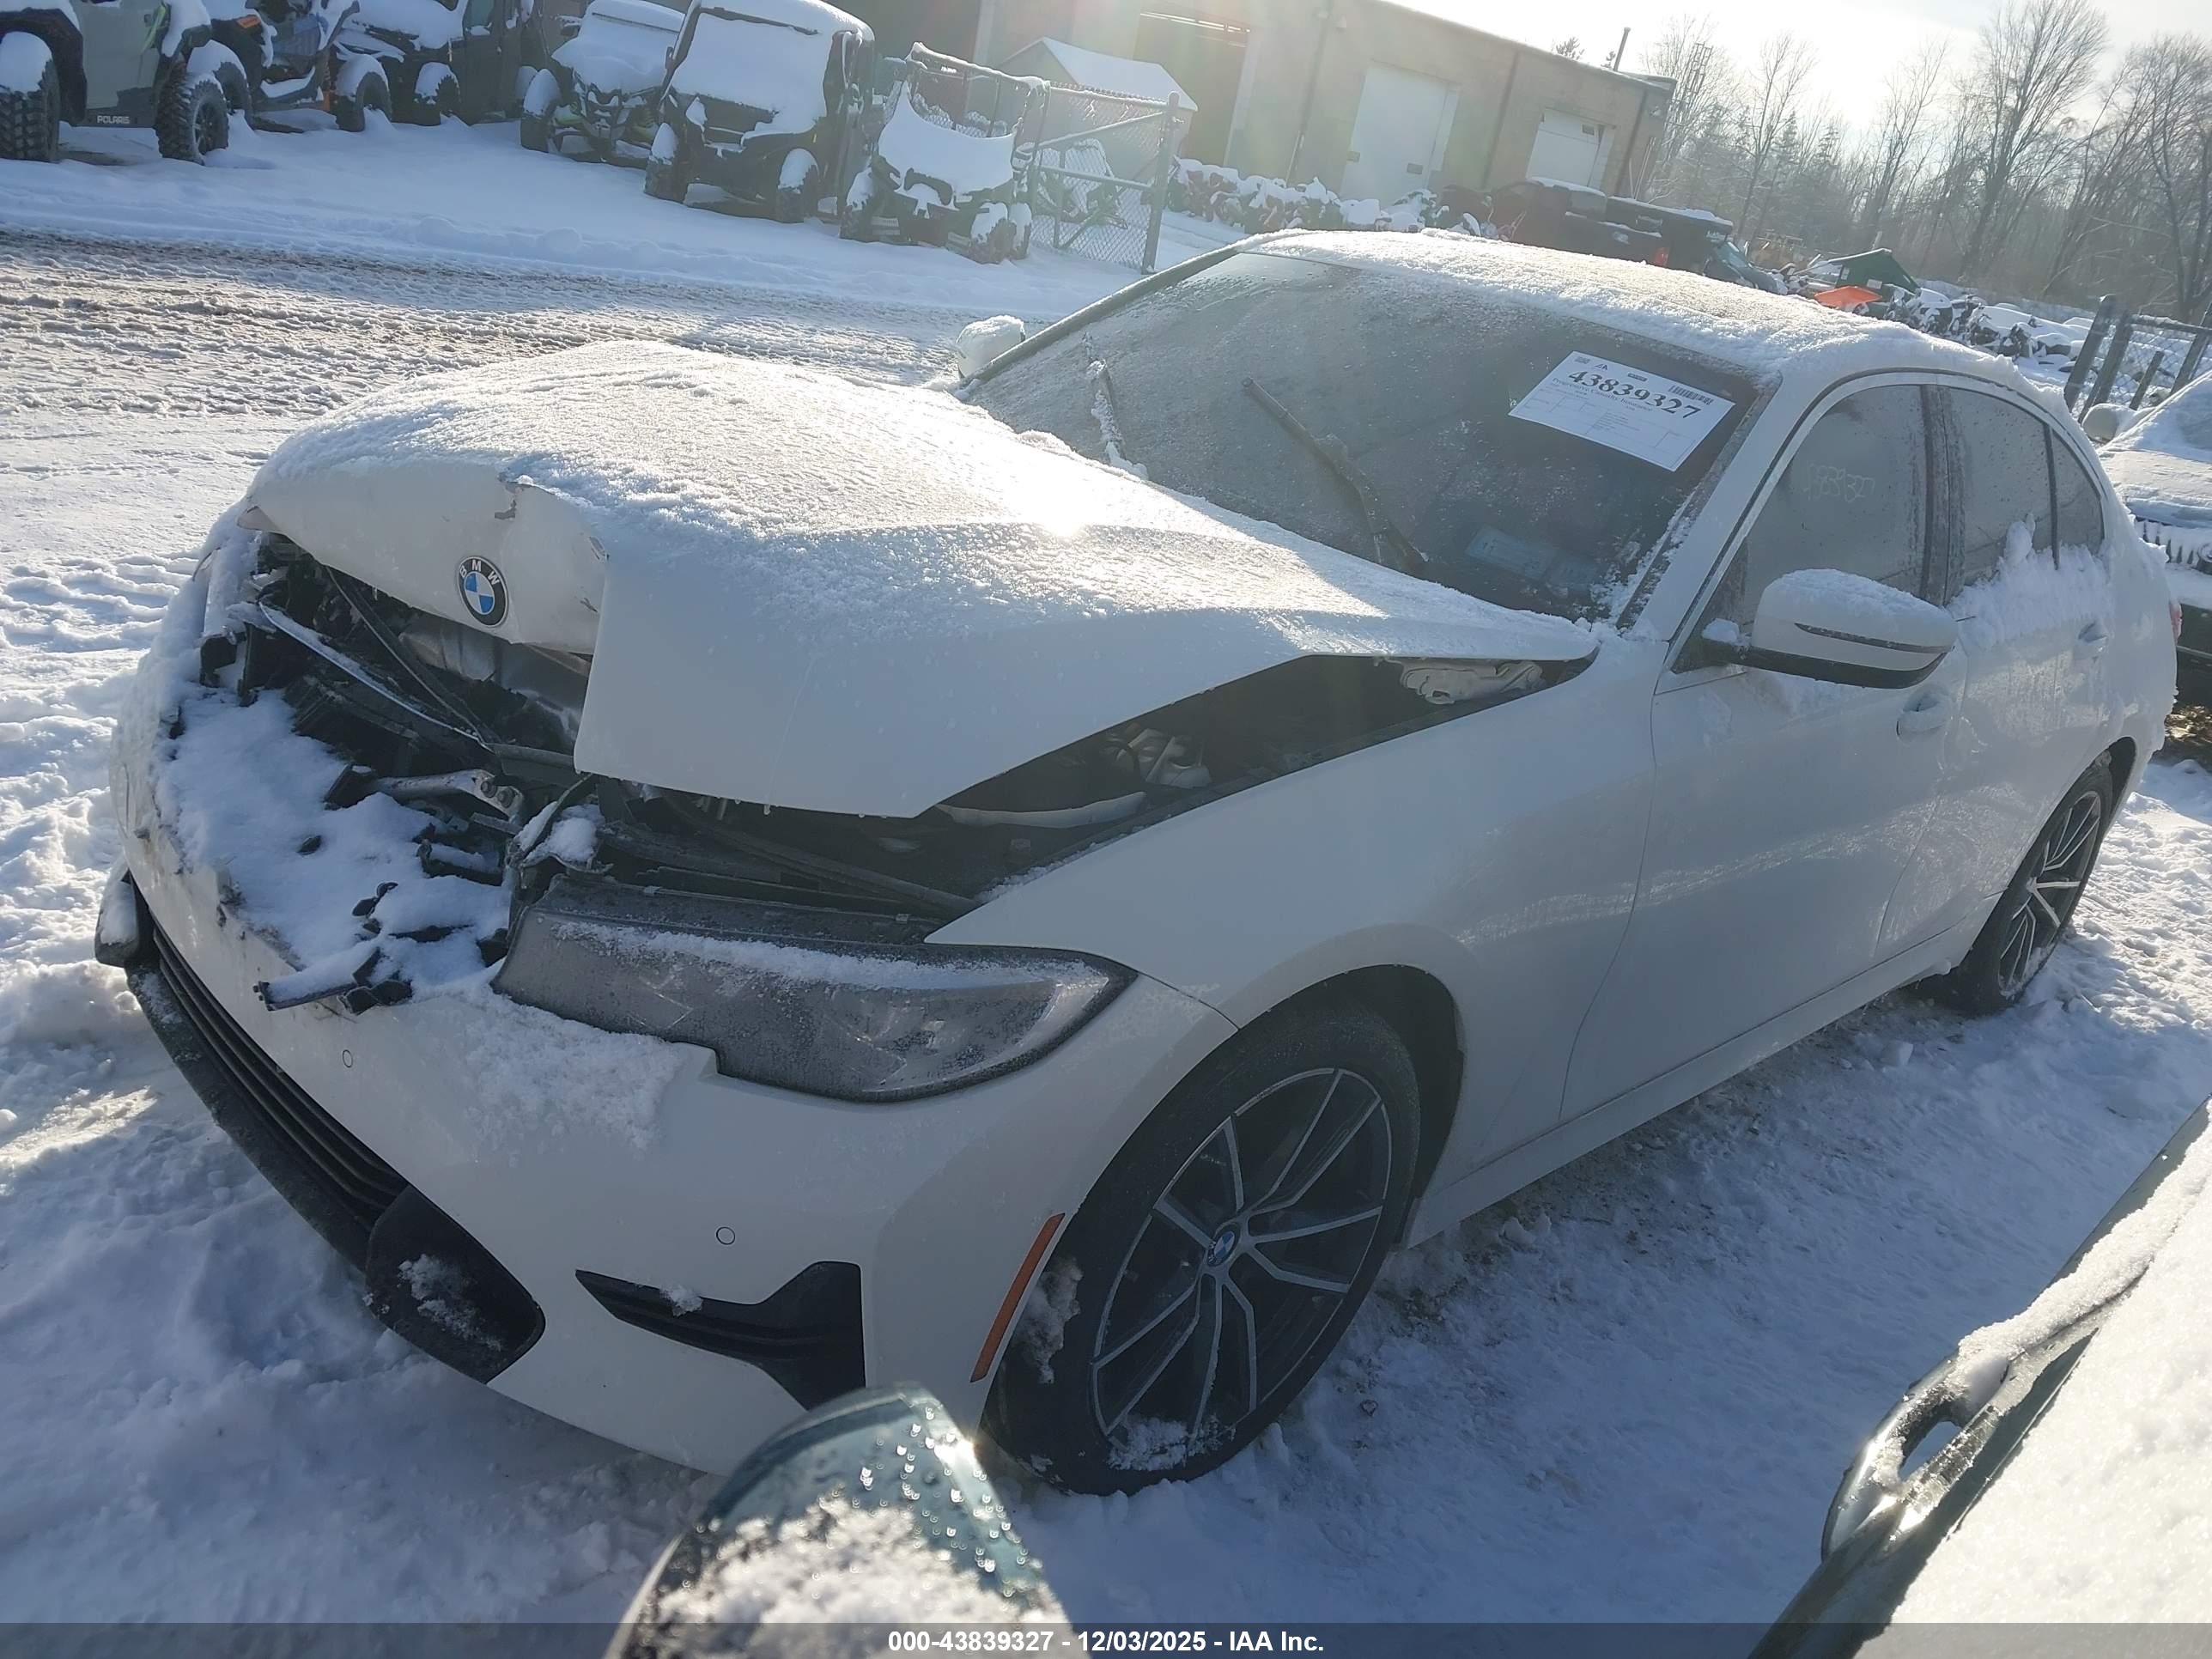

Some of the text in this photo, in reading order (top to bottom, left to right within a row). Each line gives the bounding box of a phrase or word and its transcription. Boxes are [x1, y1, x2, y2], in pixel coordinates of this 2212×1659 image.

[97, 115, 131, 125] POLARIS
[1568, 370, 1701, 419] 43839327
[459, 559, 500, 586] BMW
